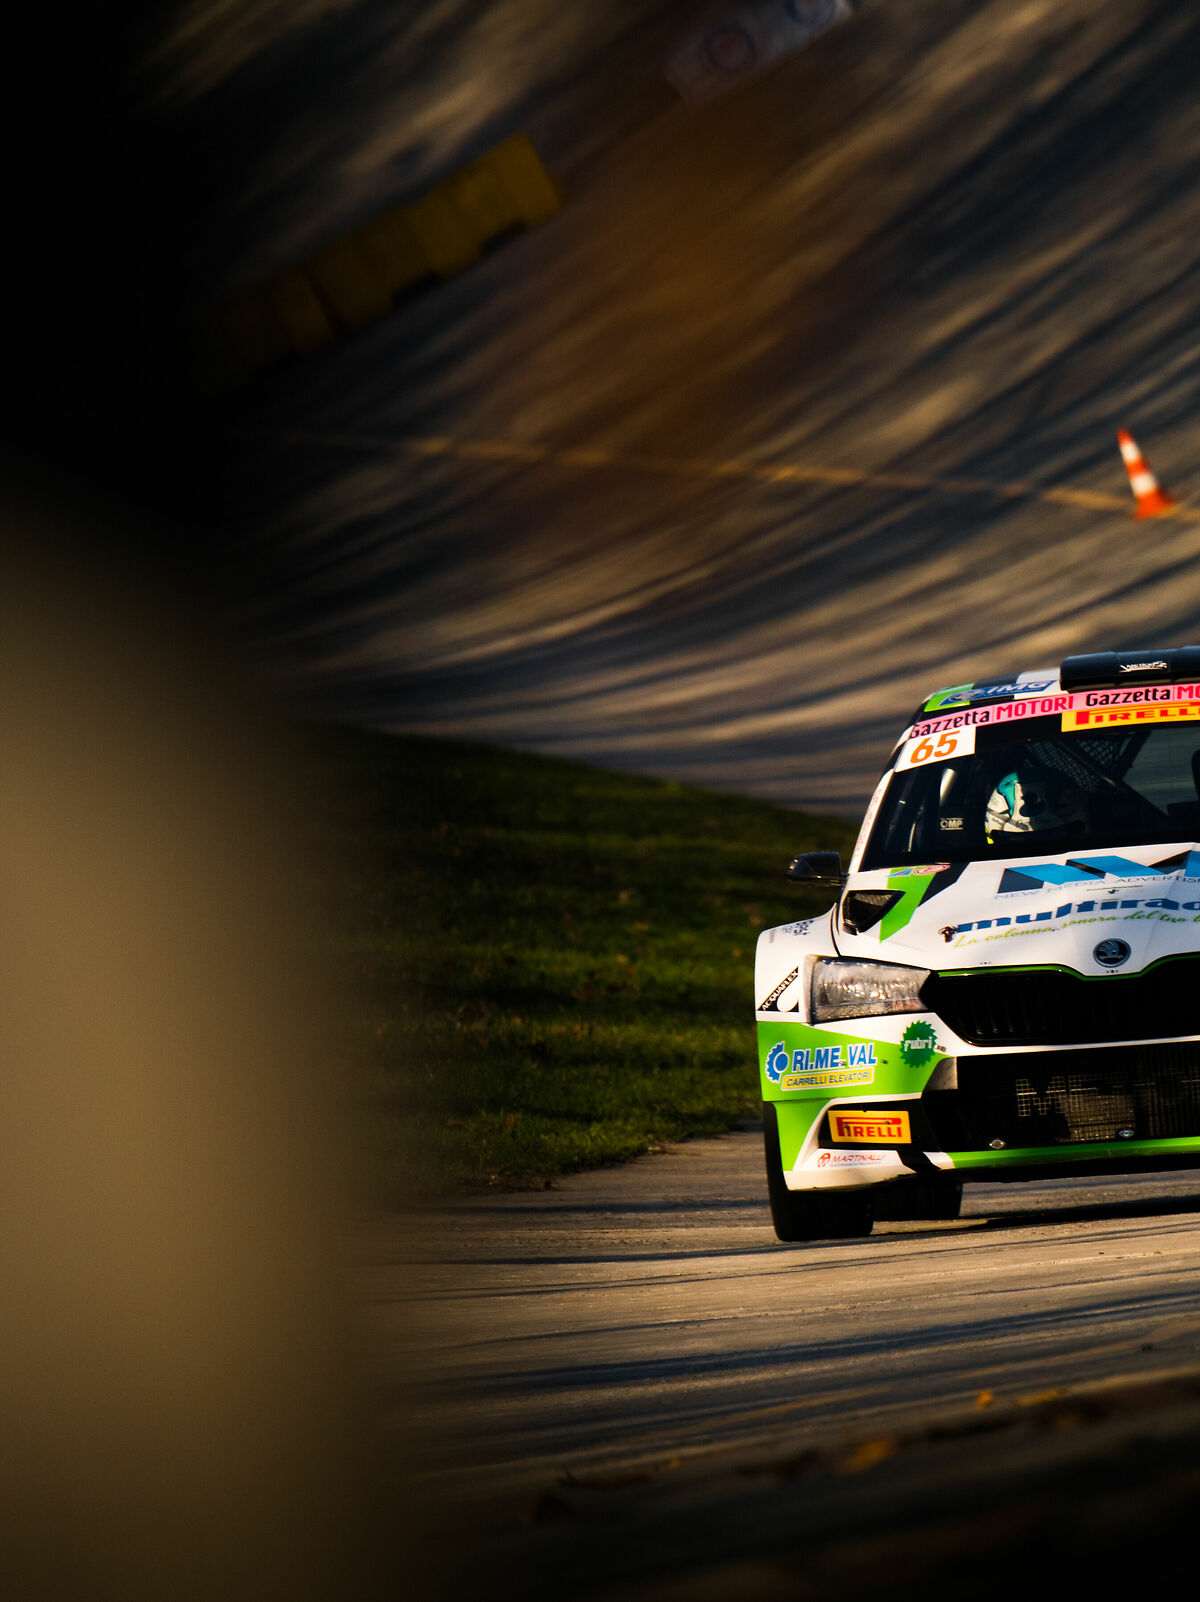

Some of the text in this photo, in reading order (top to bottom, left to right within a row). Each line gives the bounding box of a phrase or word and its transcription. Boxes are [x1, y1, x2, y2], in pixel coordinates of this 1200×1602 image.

[910, 710, 990, 739] Gazzetta
[996, 696, 1074, 720] MOTORI
[1086, 688, 1171, 706] Gazzetta
[910, 730, 960, 764] 65
[940, 819, 964, 829] OMP
[994, 890, 1037, 900] NEW
[1047, 880, 1105, 893] MEDIA
[953, 935, 977, 948] La
[985, 927, 1053, 941] colonna
[1062, 916, 1117, 929] sonora
[1123, 910, 1160, 921] del
[1159, 913, 1186, 923] tuo
[761, 970, 799, 1011] ACQUAFLEX
[786, 1071, 871, 1087] CARRELLI ELEVATORI
[836, 1116, 903, 1138] PIRELLI
